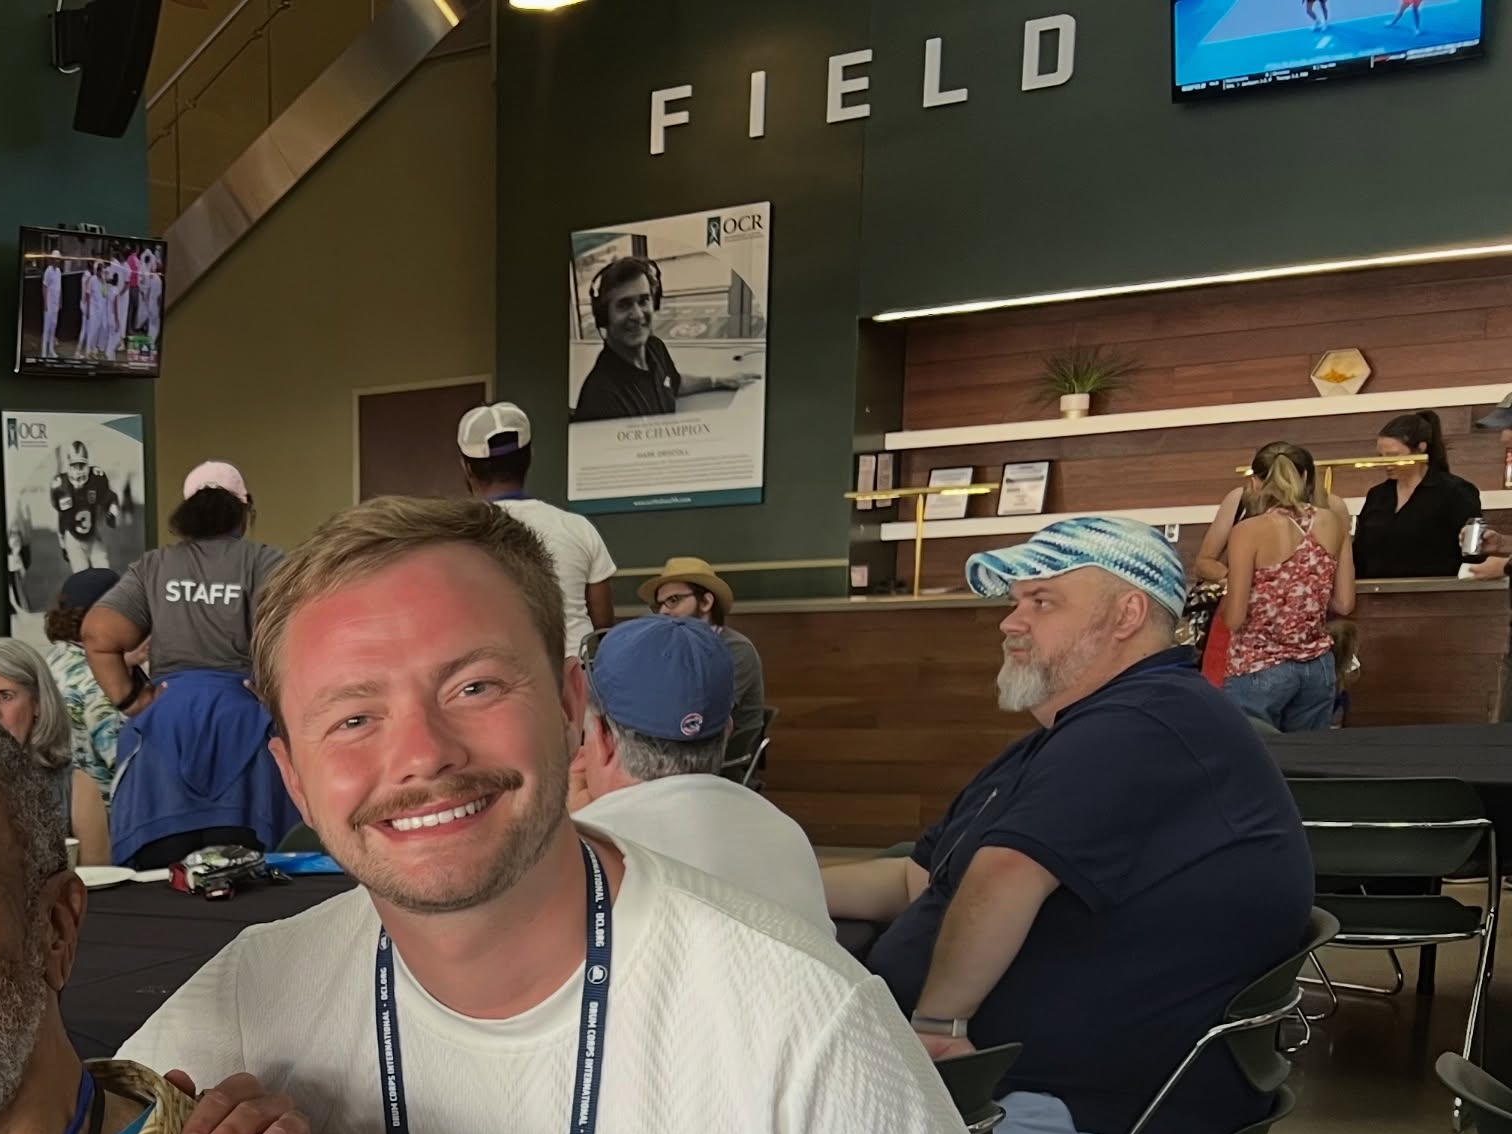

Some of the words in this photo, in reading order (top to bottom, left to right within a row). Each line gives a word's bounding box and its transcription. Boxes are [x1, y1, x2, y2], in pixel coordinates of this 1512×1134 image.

[650, 14, 1076, 155] FIELD
[723, 214, 763, 234] OCR
[19, 423, 48, 439] OCR
[617, 430, 643, 442] OCR
[645, 423, 711, 440] CHAMPION
[75, 510, 93, 535] 3
[166, 580, 242, 605] STAFF
[588, 1001, 599, 1028] DRUM
[382, 1009, 395, 1075] INTERNATIONAL
[585, 1029, 596, 1058] CORPS
[388, 1075, 398, 1102] CORPS
[579, 1058, 594, 1126] INTERNATIONAL
[391, 1102, 400, 1127] DRUM
